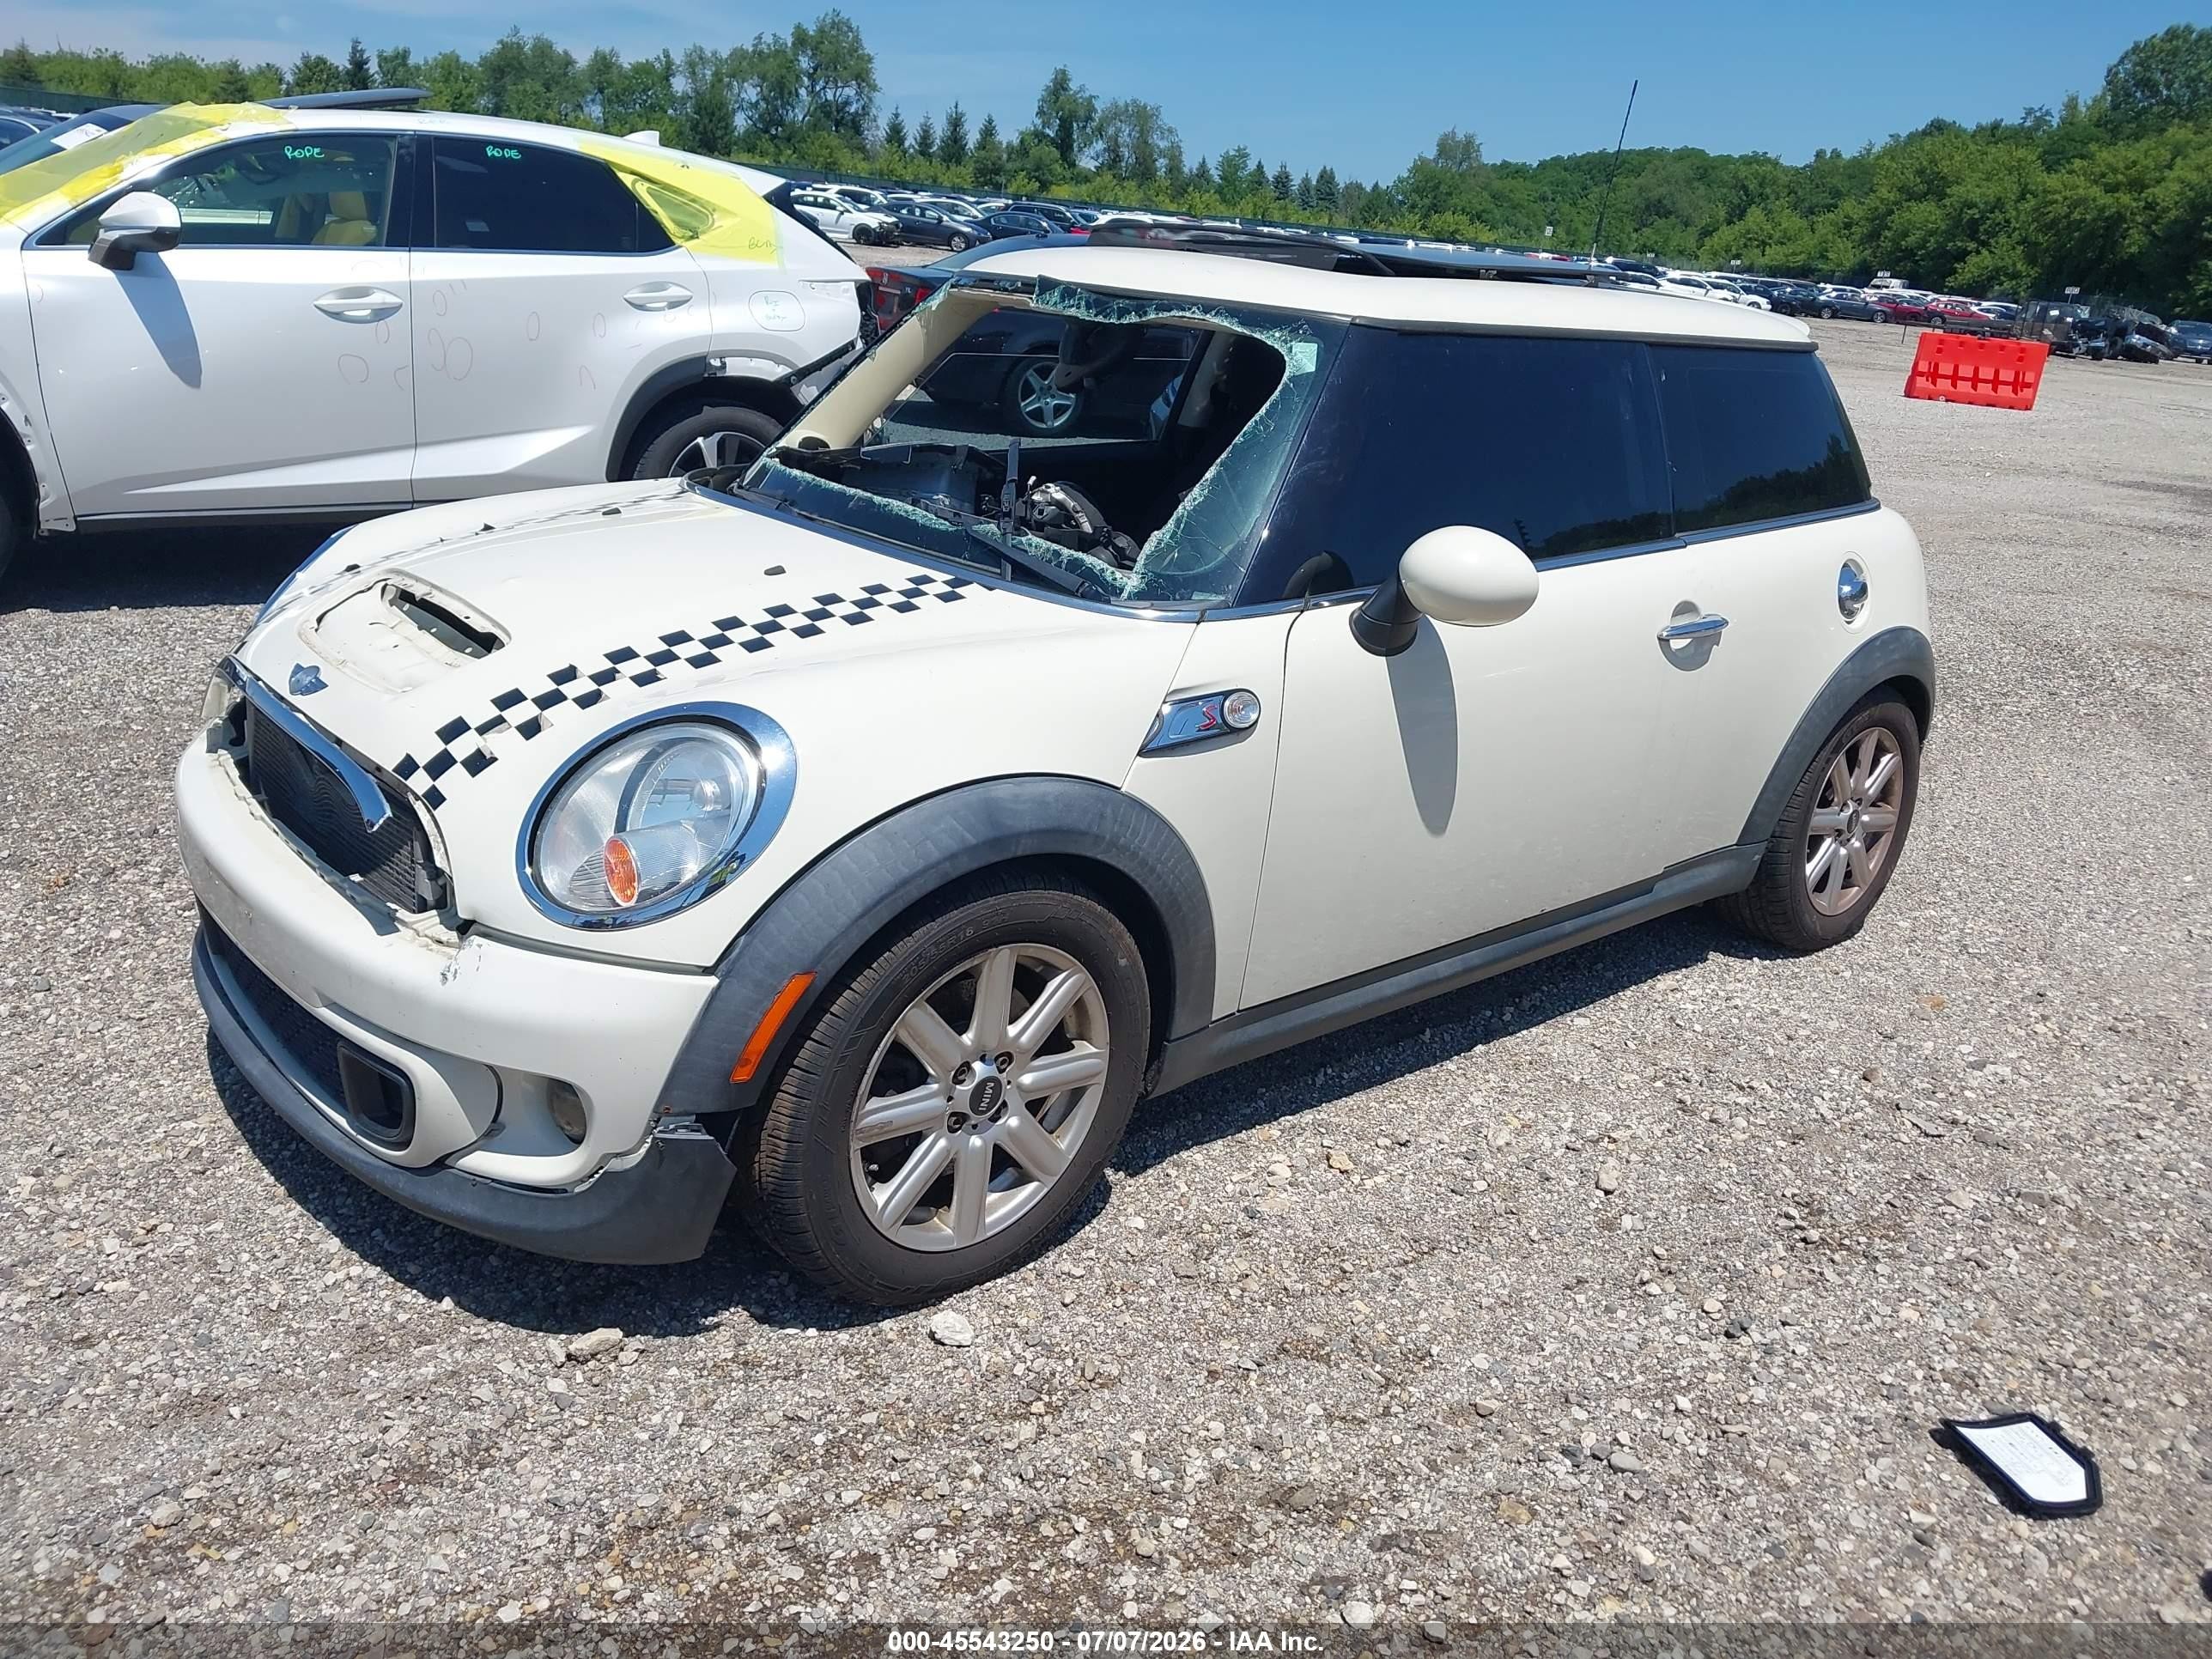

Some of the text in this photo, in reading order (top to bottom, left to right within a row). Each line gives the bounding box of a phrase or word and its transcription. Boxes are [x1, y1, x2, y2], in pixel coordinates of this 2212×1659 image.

[284, 145, 325, 160] ROPE
[1196, 704, 1218, 731] S
[978, 1082, 994, 1111] MINI
